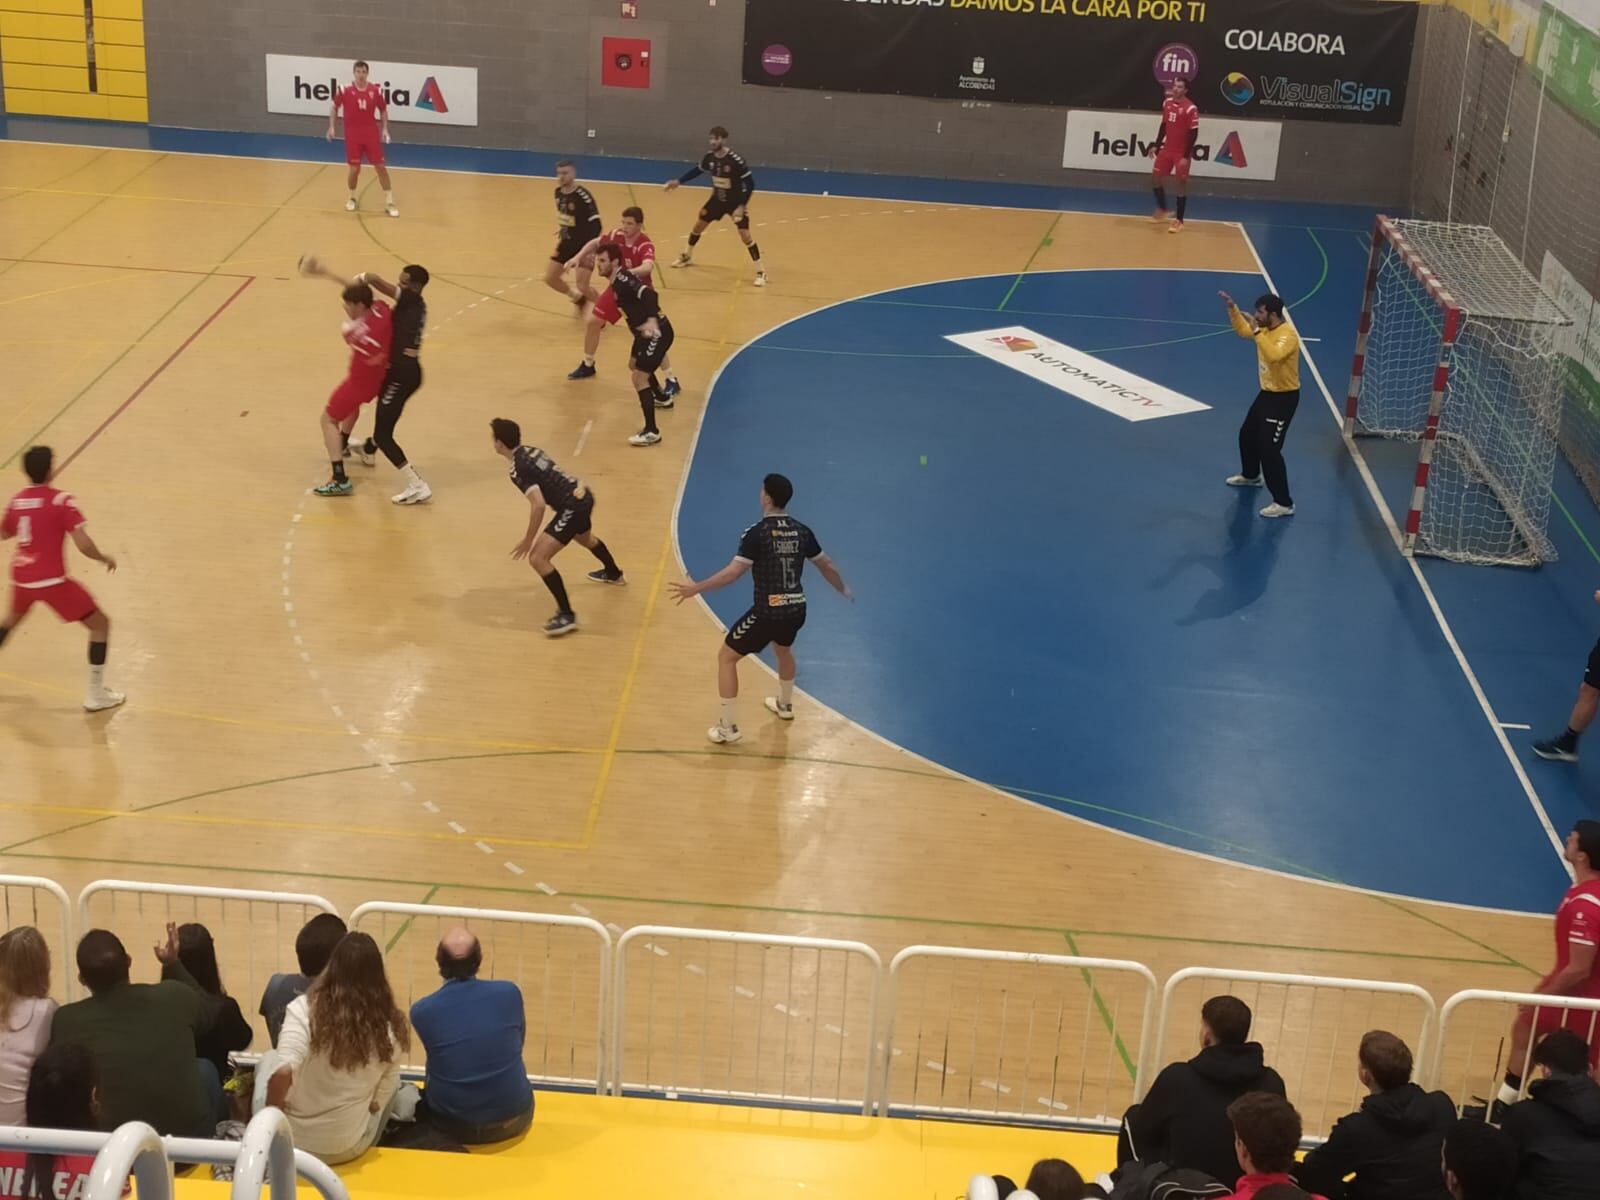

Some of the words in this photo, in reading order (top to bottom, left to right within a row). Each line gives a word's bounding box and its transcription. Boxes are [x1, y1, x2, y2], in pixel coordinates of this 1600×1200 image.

[1040, 0, 1066, 15] LA
[1071, 0, 1131, 18] CARA
[1137, 0, 1182, 21] POR
[1186, 2, 1206, 22] TI
[1224, 29, 1346, 55] COLABORA
[1162, 53, 1189, 73] fin
[294, 75, 411, 107] helia
[1260, 75, 1392, 112] VisualSign
[1091, 131, 1210, 162] helva
[1025, 352, 1163, 407] AUTOMATICTV
